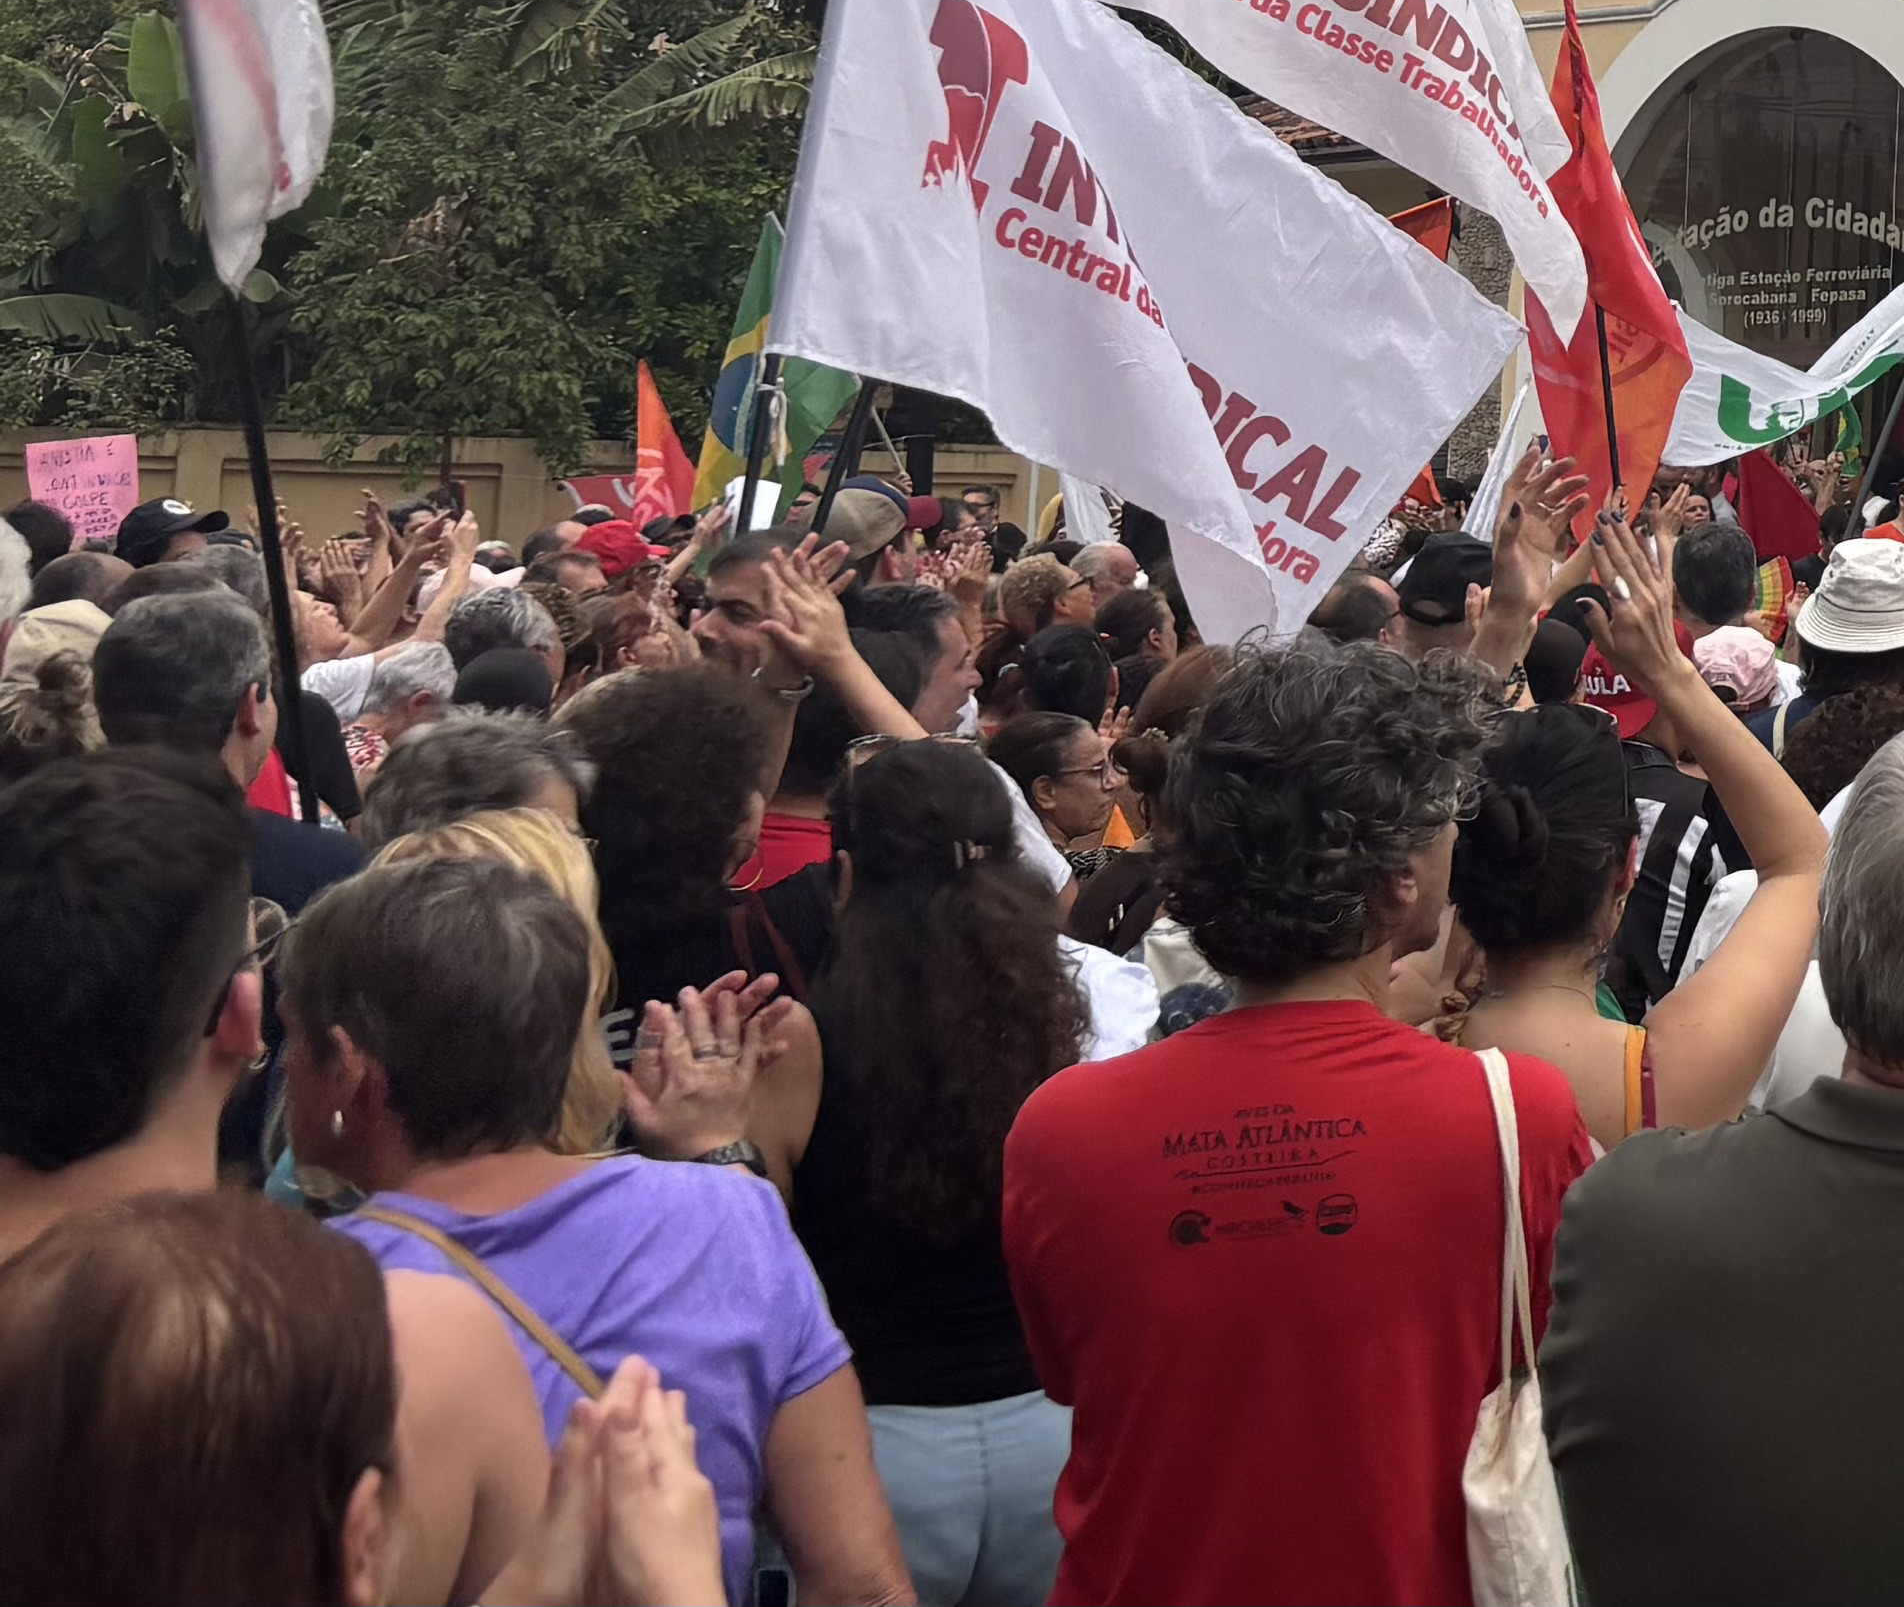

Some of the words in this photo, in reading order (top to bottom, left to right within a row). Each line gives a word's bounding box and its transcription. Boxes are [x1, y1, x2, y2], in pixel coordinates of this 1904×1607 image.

[1295, 4, 1394, 74] Classe
[1398, 51, 1551, 220] Trabalhadora
[1759, 198, 1794, 228] da
[995, 206, 1132, 302] Central
[1740, 269, 1801, 288] Estação
[1806, 265, 1892, 283] Ferroviária
[1811, 287, 1866, 303] Fepasa
[1163, 1129, 1229, 1158] MATA
[1236, 1118, 1367, 1150] ATLÂNTICA
[1206, 1148, 1320, 1170] COSTEIRA
